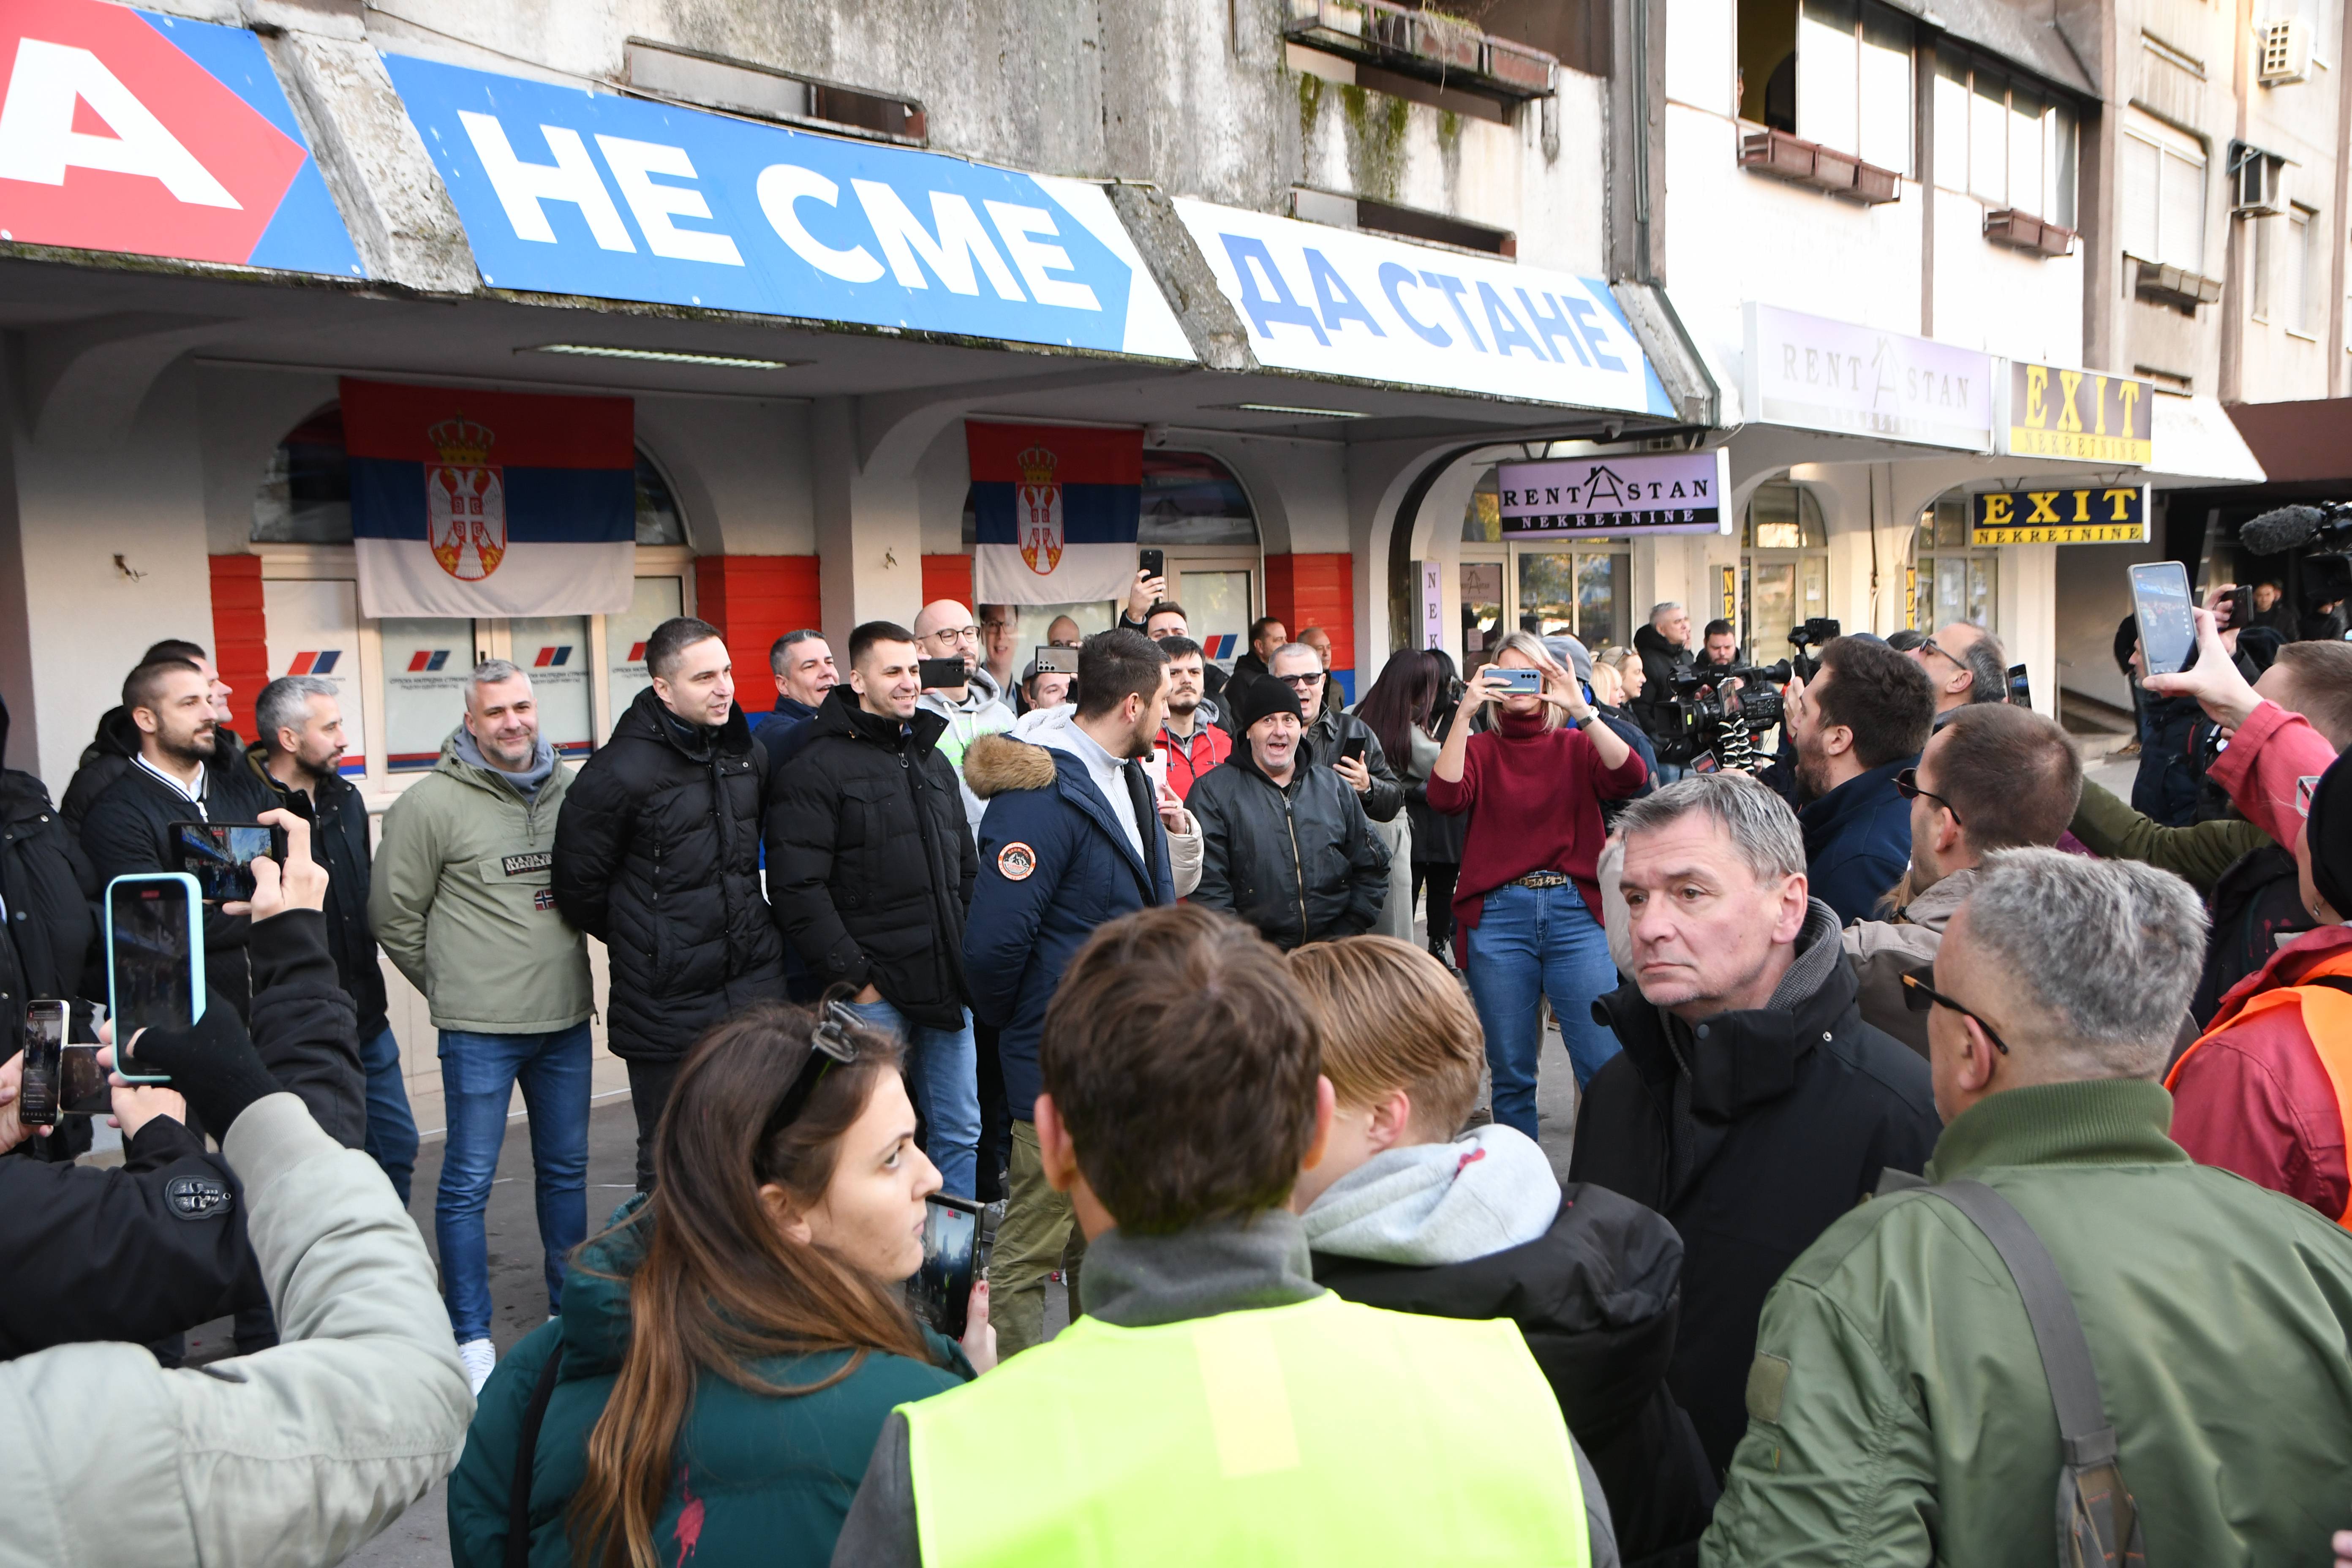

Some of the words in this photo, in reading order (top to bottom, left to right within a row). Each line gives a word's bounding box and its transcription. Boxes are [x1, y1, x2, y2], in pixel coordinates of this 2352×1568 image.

[457, 109, 745, 266] НЕ
[757, 164, 1102, 311] СМЕ
[1218, 232, 1387, 347] ДА
[1378, 262, 1628, 373] СТАНЕ
[2024, 365, 2139, 438] EXIT
[2024, 432, 2137, 460] NEKRETNINE
[1522, 509, 1694, 529] NEKRETNINE
[1982, 488, 2137, 525] EXIT
[1978, 528, 2140, 544] NEKRETNINE
[1723, 570, 1734, 626] NE
